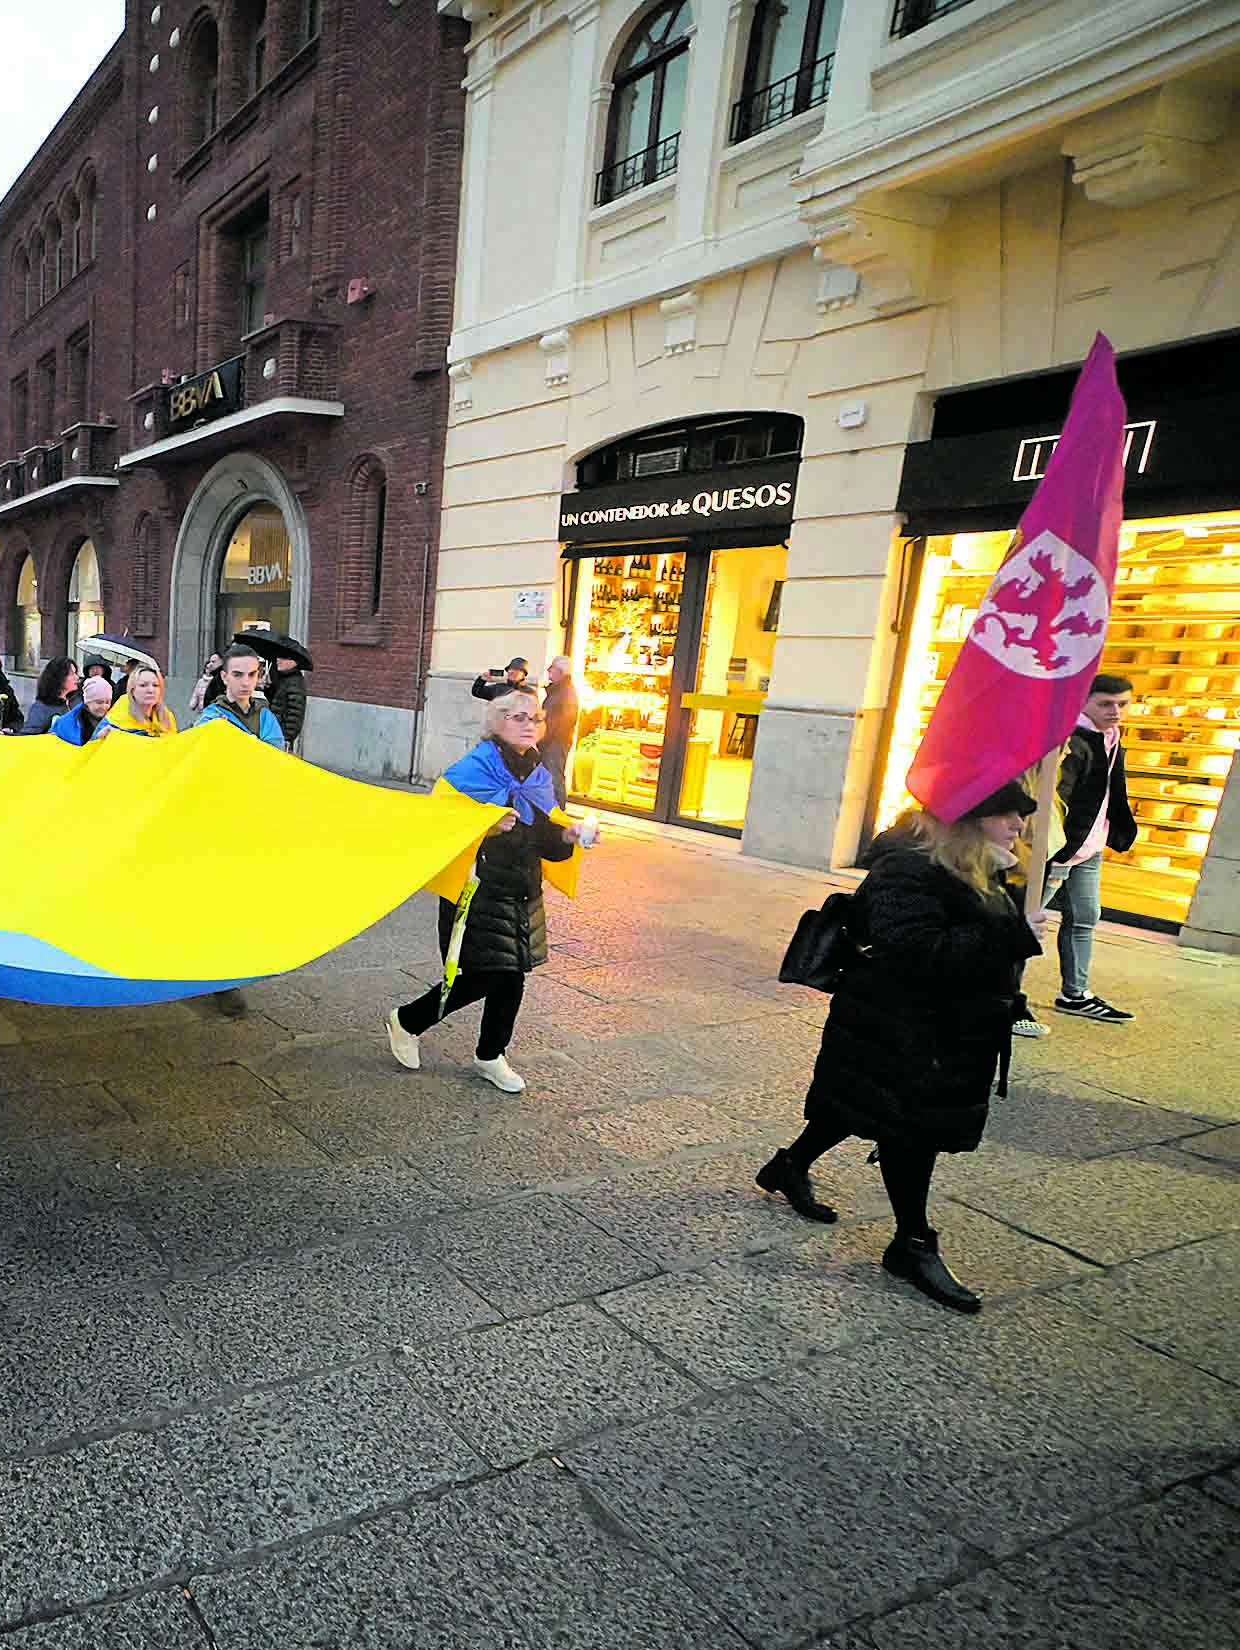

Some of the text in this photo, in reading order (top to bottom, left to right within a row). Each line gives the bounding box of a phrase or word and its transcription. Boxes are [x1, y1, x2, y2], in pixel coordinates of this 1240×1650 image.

[170, 371, 224, 422] BBVA
[561, 482, 792, 527] UN CONTENEDOR de QUESOS
[248, 562, 283, 585] BBVA
